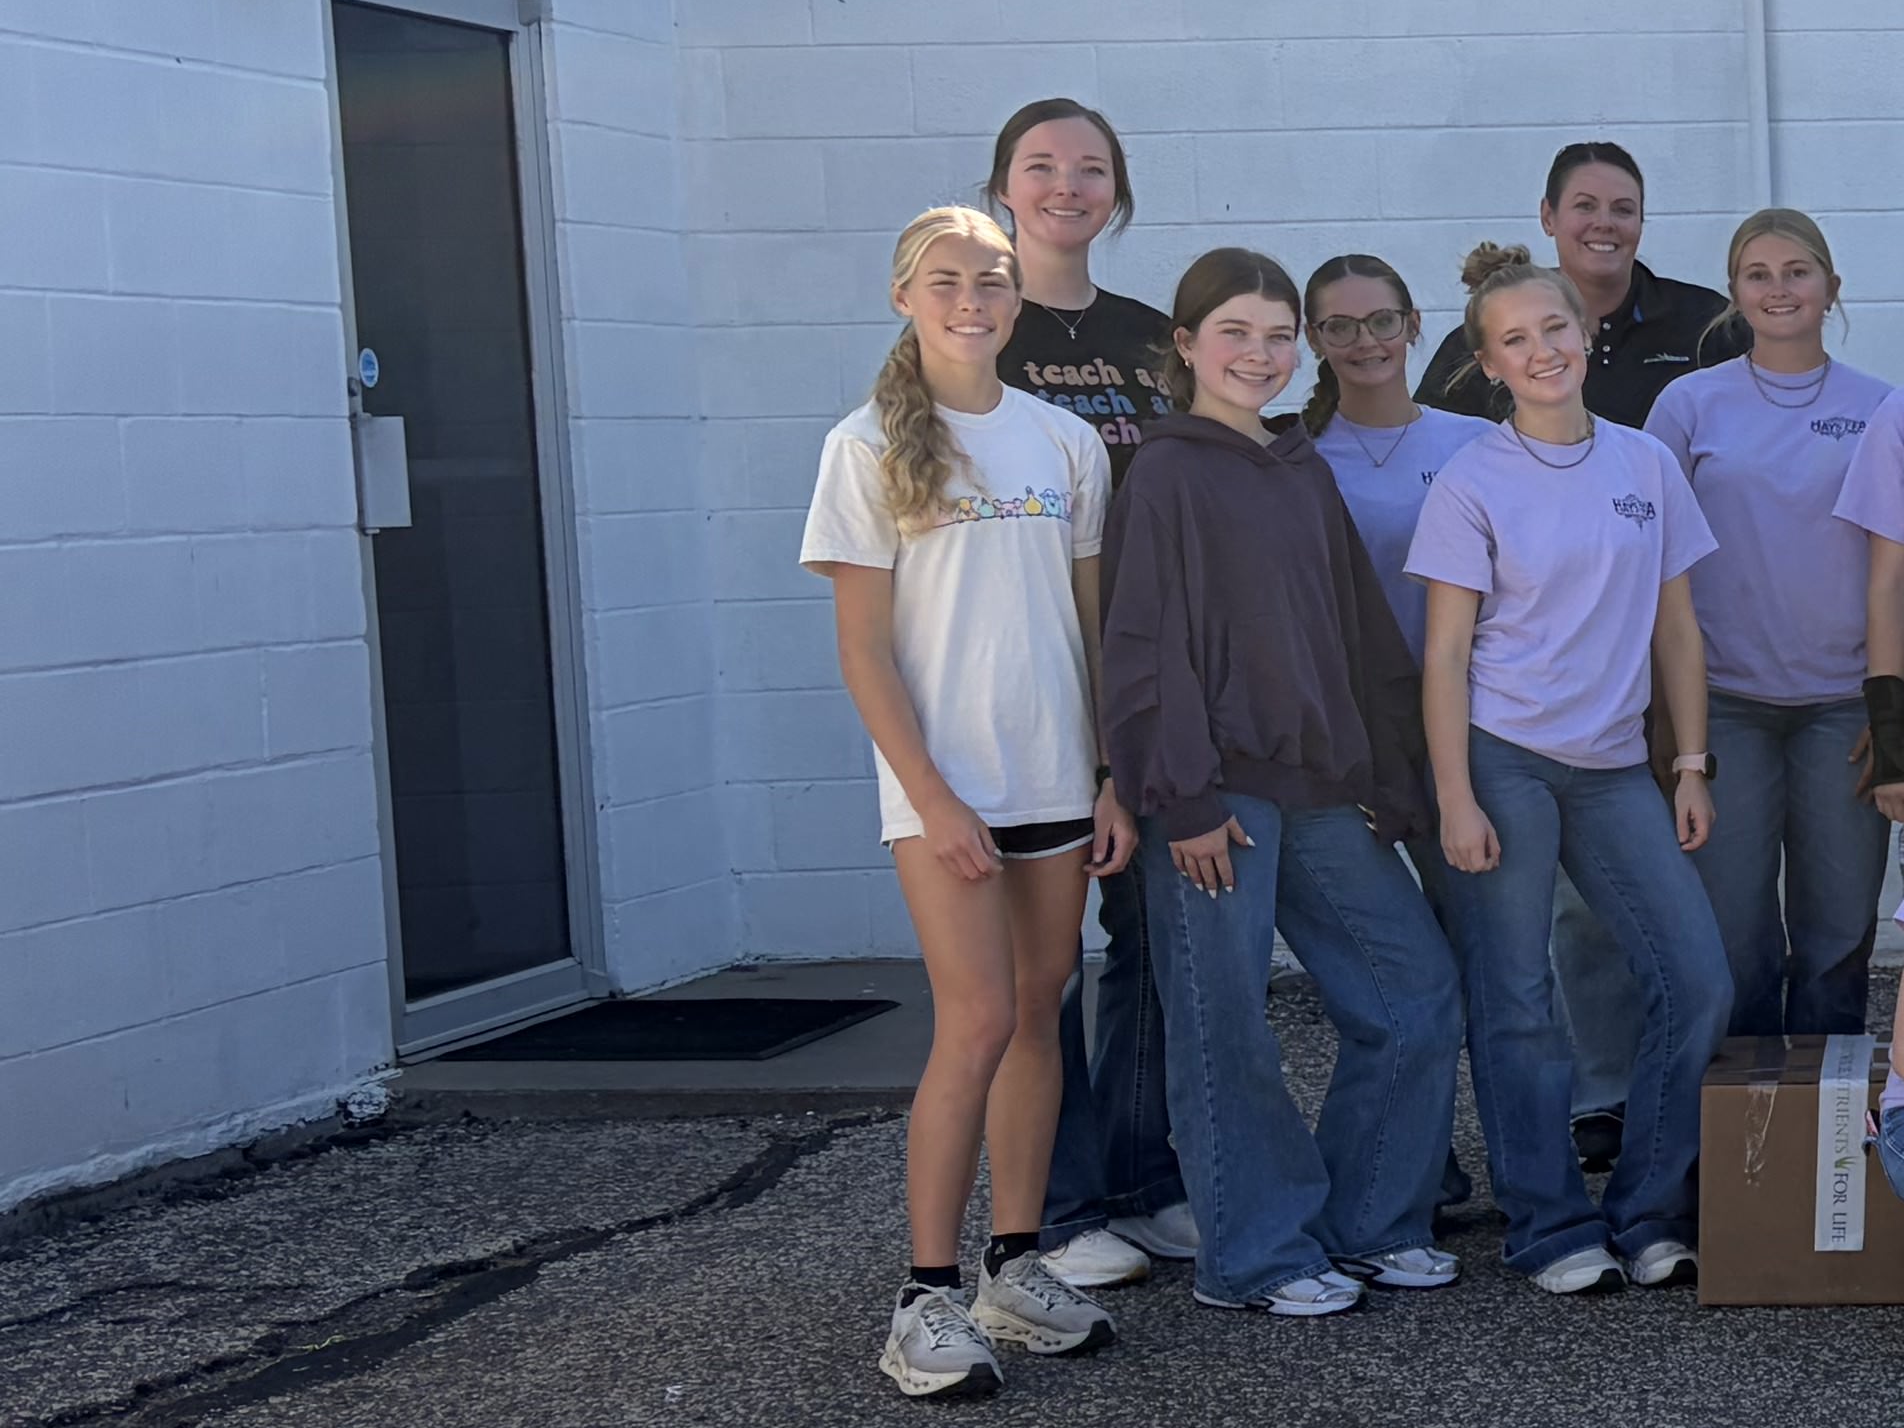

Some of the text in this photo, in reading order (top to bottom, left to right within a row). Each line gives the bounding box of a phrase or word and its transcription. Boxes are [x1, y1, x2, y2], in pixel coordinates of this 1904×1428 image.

[1023, 357, 1125, 386] teach
[1035, 387, 1137, 415] teach
[1833, 1173, 1849, 1205] FOR
[1831, 1213, 1847, 1243] LIFE
